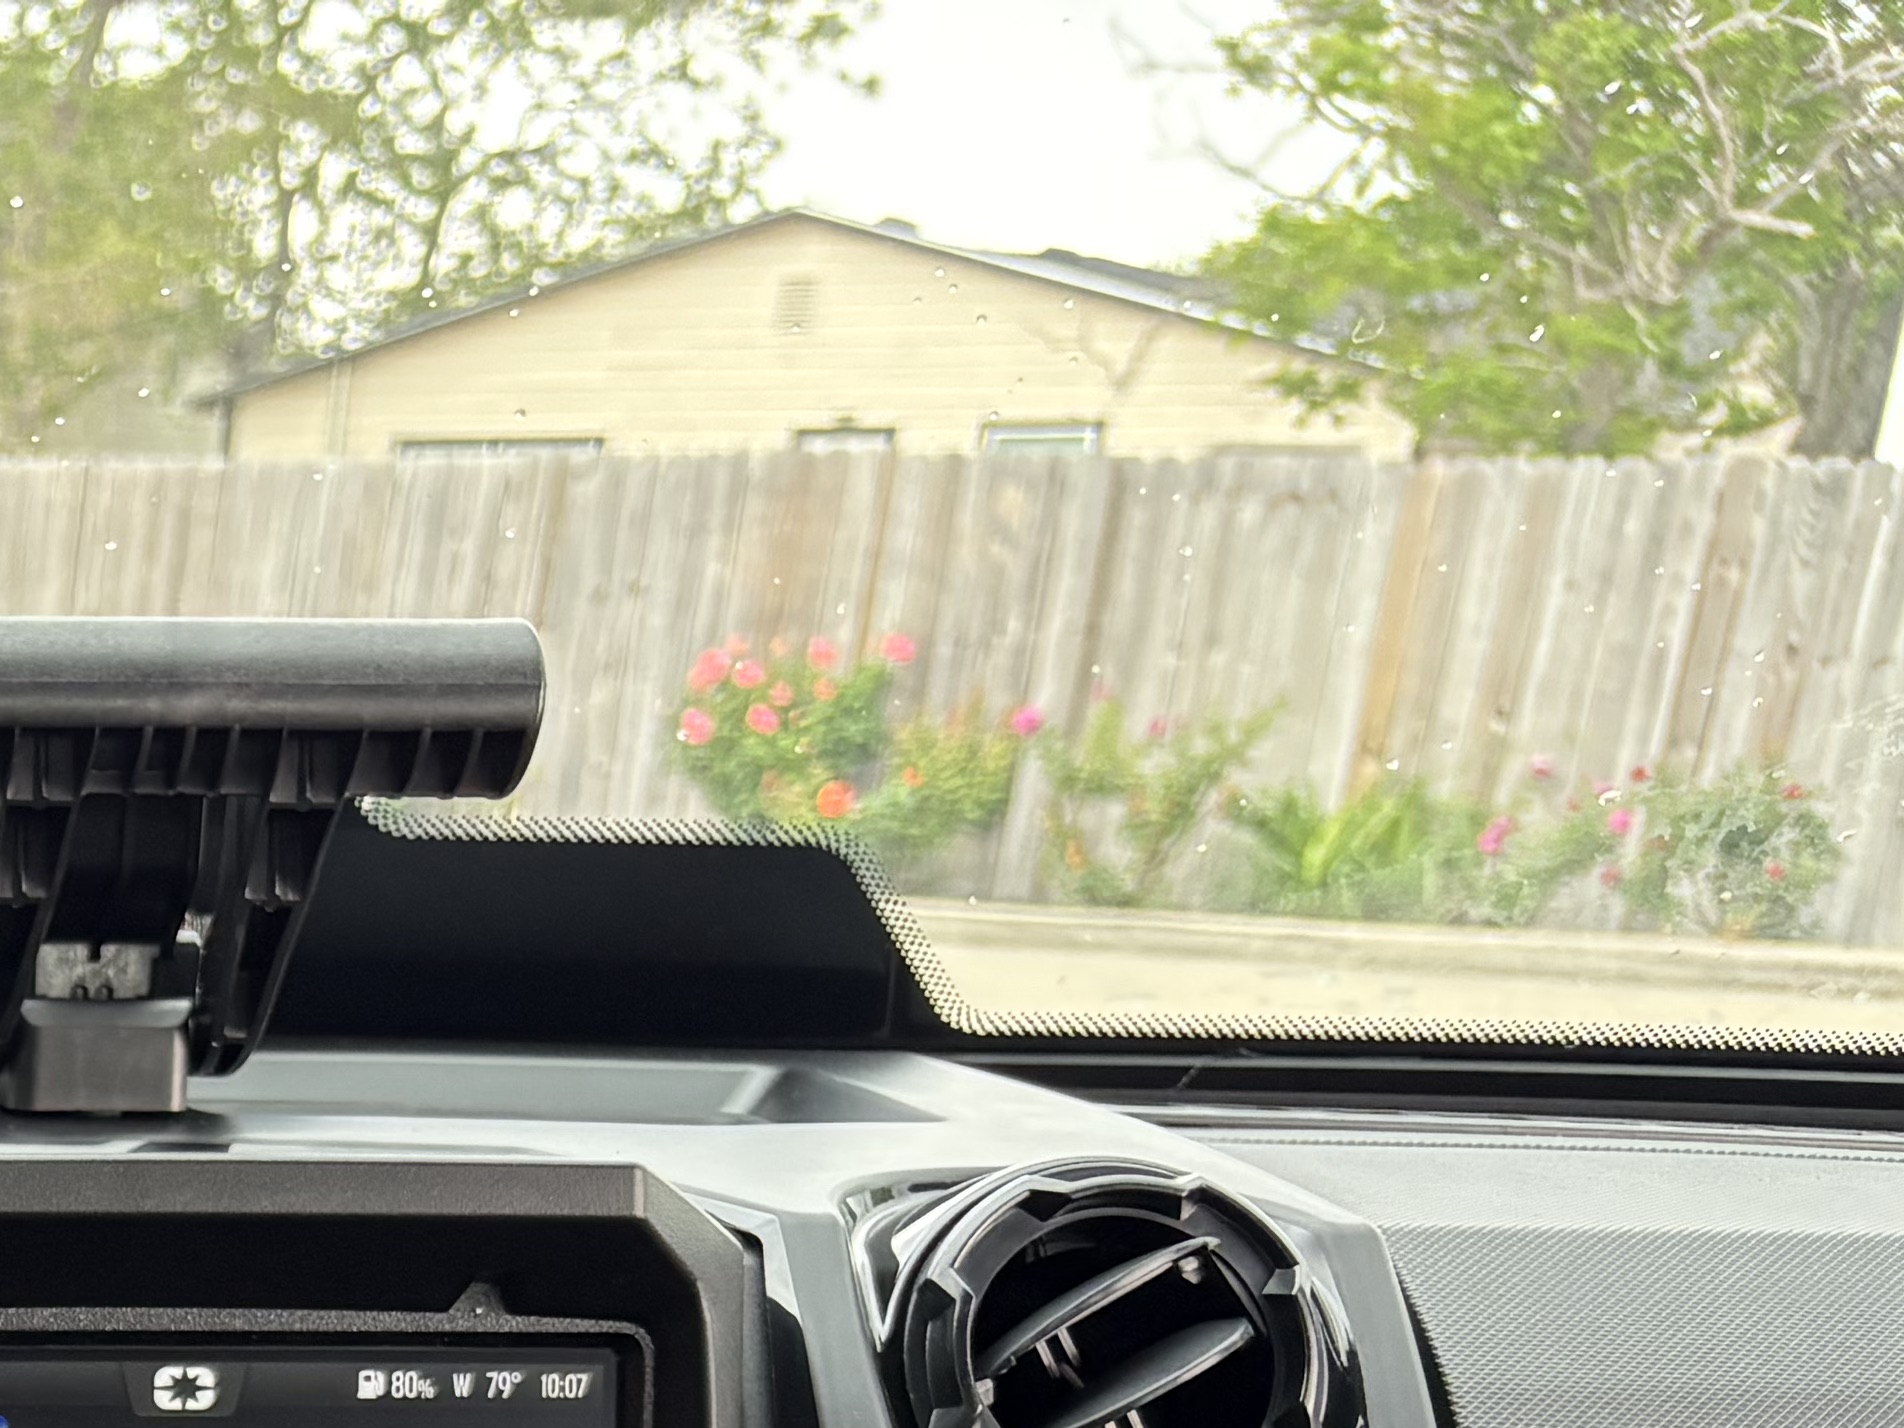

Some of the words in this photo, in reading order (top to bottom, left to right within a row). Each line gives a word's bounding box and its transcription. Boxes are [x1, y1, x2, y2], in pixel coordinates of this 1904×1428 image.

[391, 1370, 435, 1399] 80%
[452, 1373, 472, 1398] W
[540, 1373, 589, 1398] 10:07
